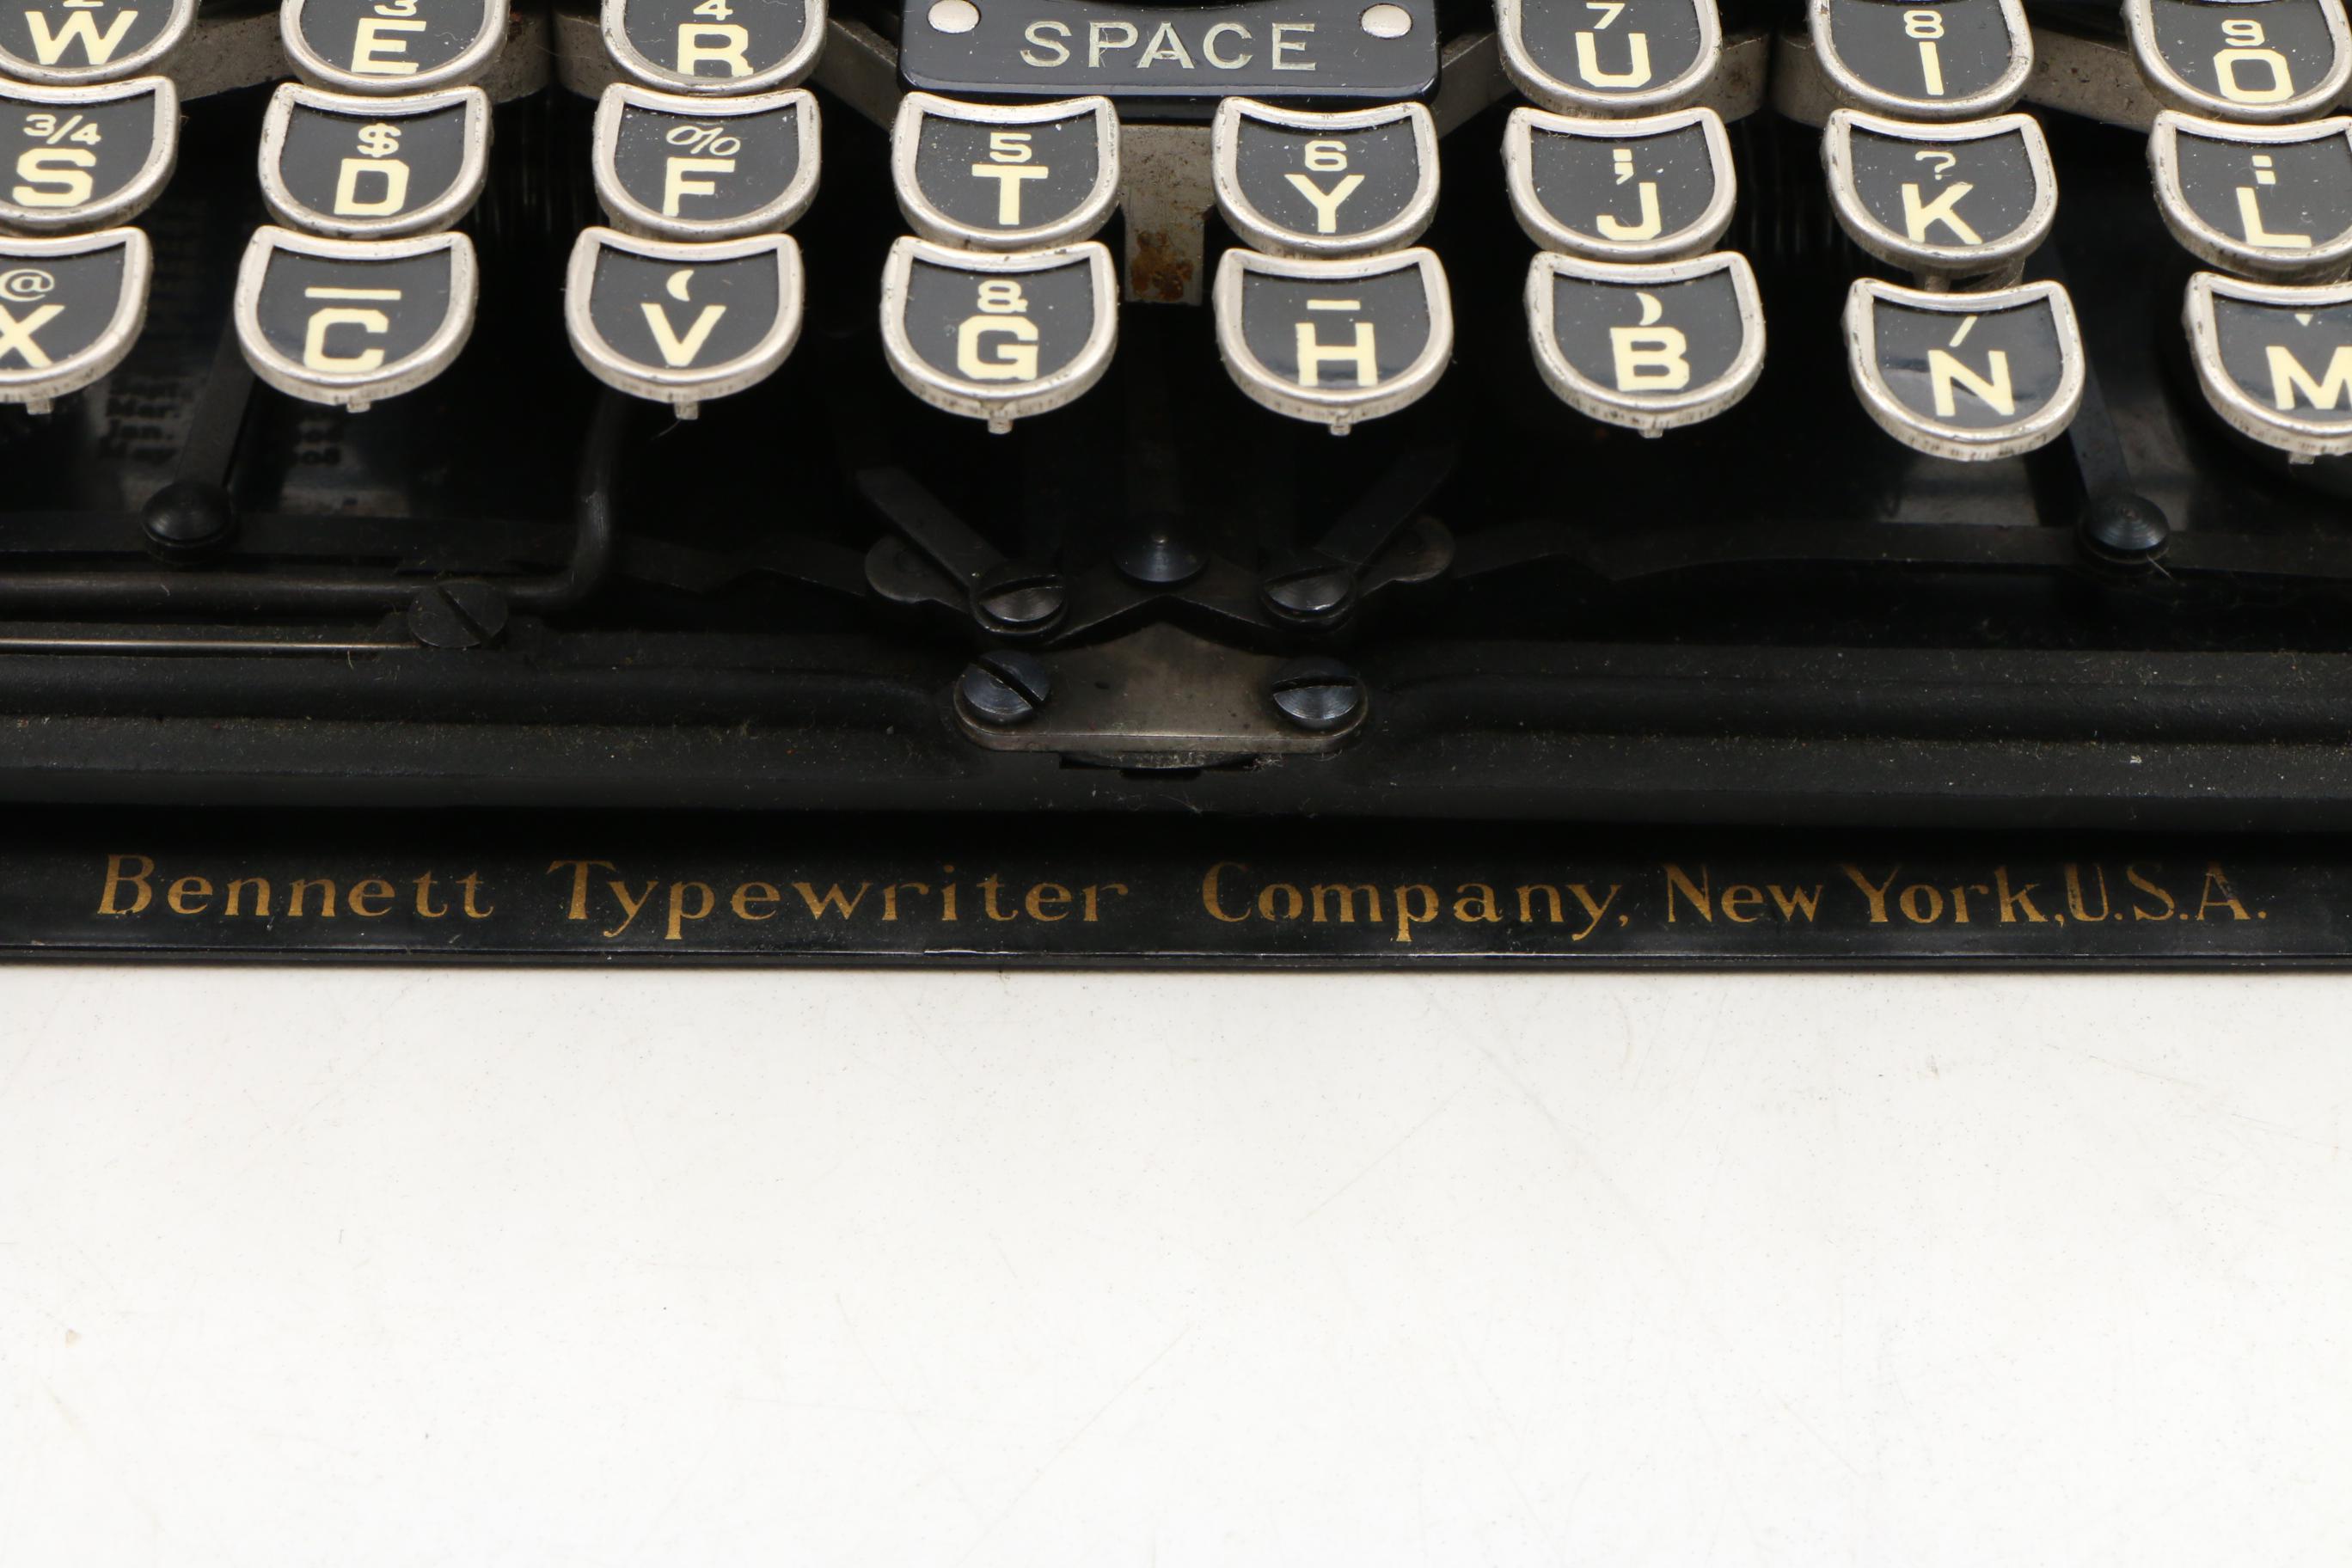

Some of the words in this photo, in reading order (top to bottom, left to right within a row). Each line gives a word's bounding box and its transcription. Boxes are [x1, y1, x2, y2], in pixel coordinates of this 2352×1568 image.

[24, 10, 138, 65] W
[1586, 2, 1626, 29] 7
[1903, 10, 1945, 39] 8
[2221, 19, 2265, 46] 9
[351, 17, 427, 75] E
[677, 23, 754, 77] R
[1020, 21, 1317, 70] SPACE
[1575, 32, 1651, 88] U
[1919, 41, 1944, 95] I
[2213, 48, 2294, 102] O
[23, 113, 101, 145] 3/4
[357, 123, 401, 157] $
[666, 126, 740, 156] %
[989, 132, 1032, 163] 5
[1305, 140, 1347, 172] 6
[12, 148, 97, 207] S
[334, 158, 410, 216] D
[663, 157, 736, 217] F
[971, 163, 1048, 225] T
[1914, 150, 1957, 181] ?
[1284, 175, 1364, 233] Y
[1596, 182, 1662, 241] J
[1901, 181, 1983, 245] K
[2236, 187, 2313, 248] L
[0, 268, 55, 302] @
[0, 303, 65, 370] X
[303, 307, 389, 372] C
[640, 303, 726, 366] V
[957, 315, 1038, 380] G
[1295, 322, 1377, 387] H
[1610, 326, 1689, 391] B
[1927, 349, 2015, 417] N
[2265, 346, 2352, 411] M
[96, 854, 496, 920] Bennett
[546, 859, 1129, 941] Typewriter
[1202, 862, 1631, 943] Company,
[1664, 864, 1821, 924] New
